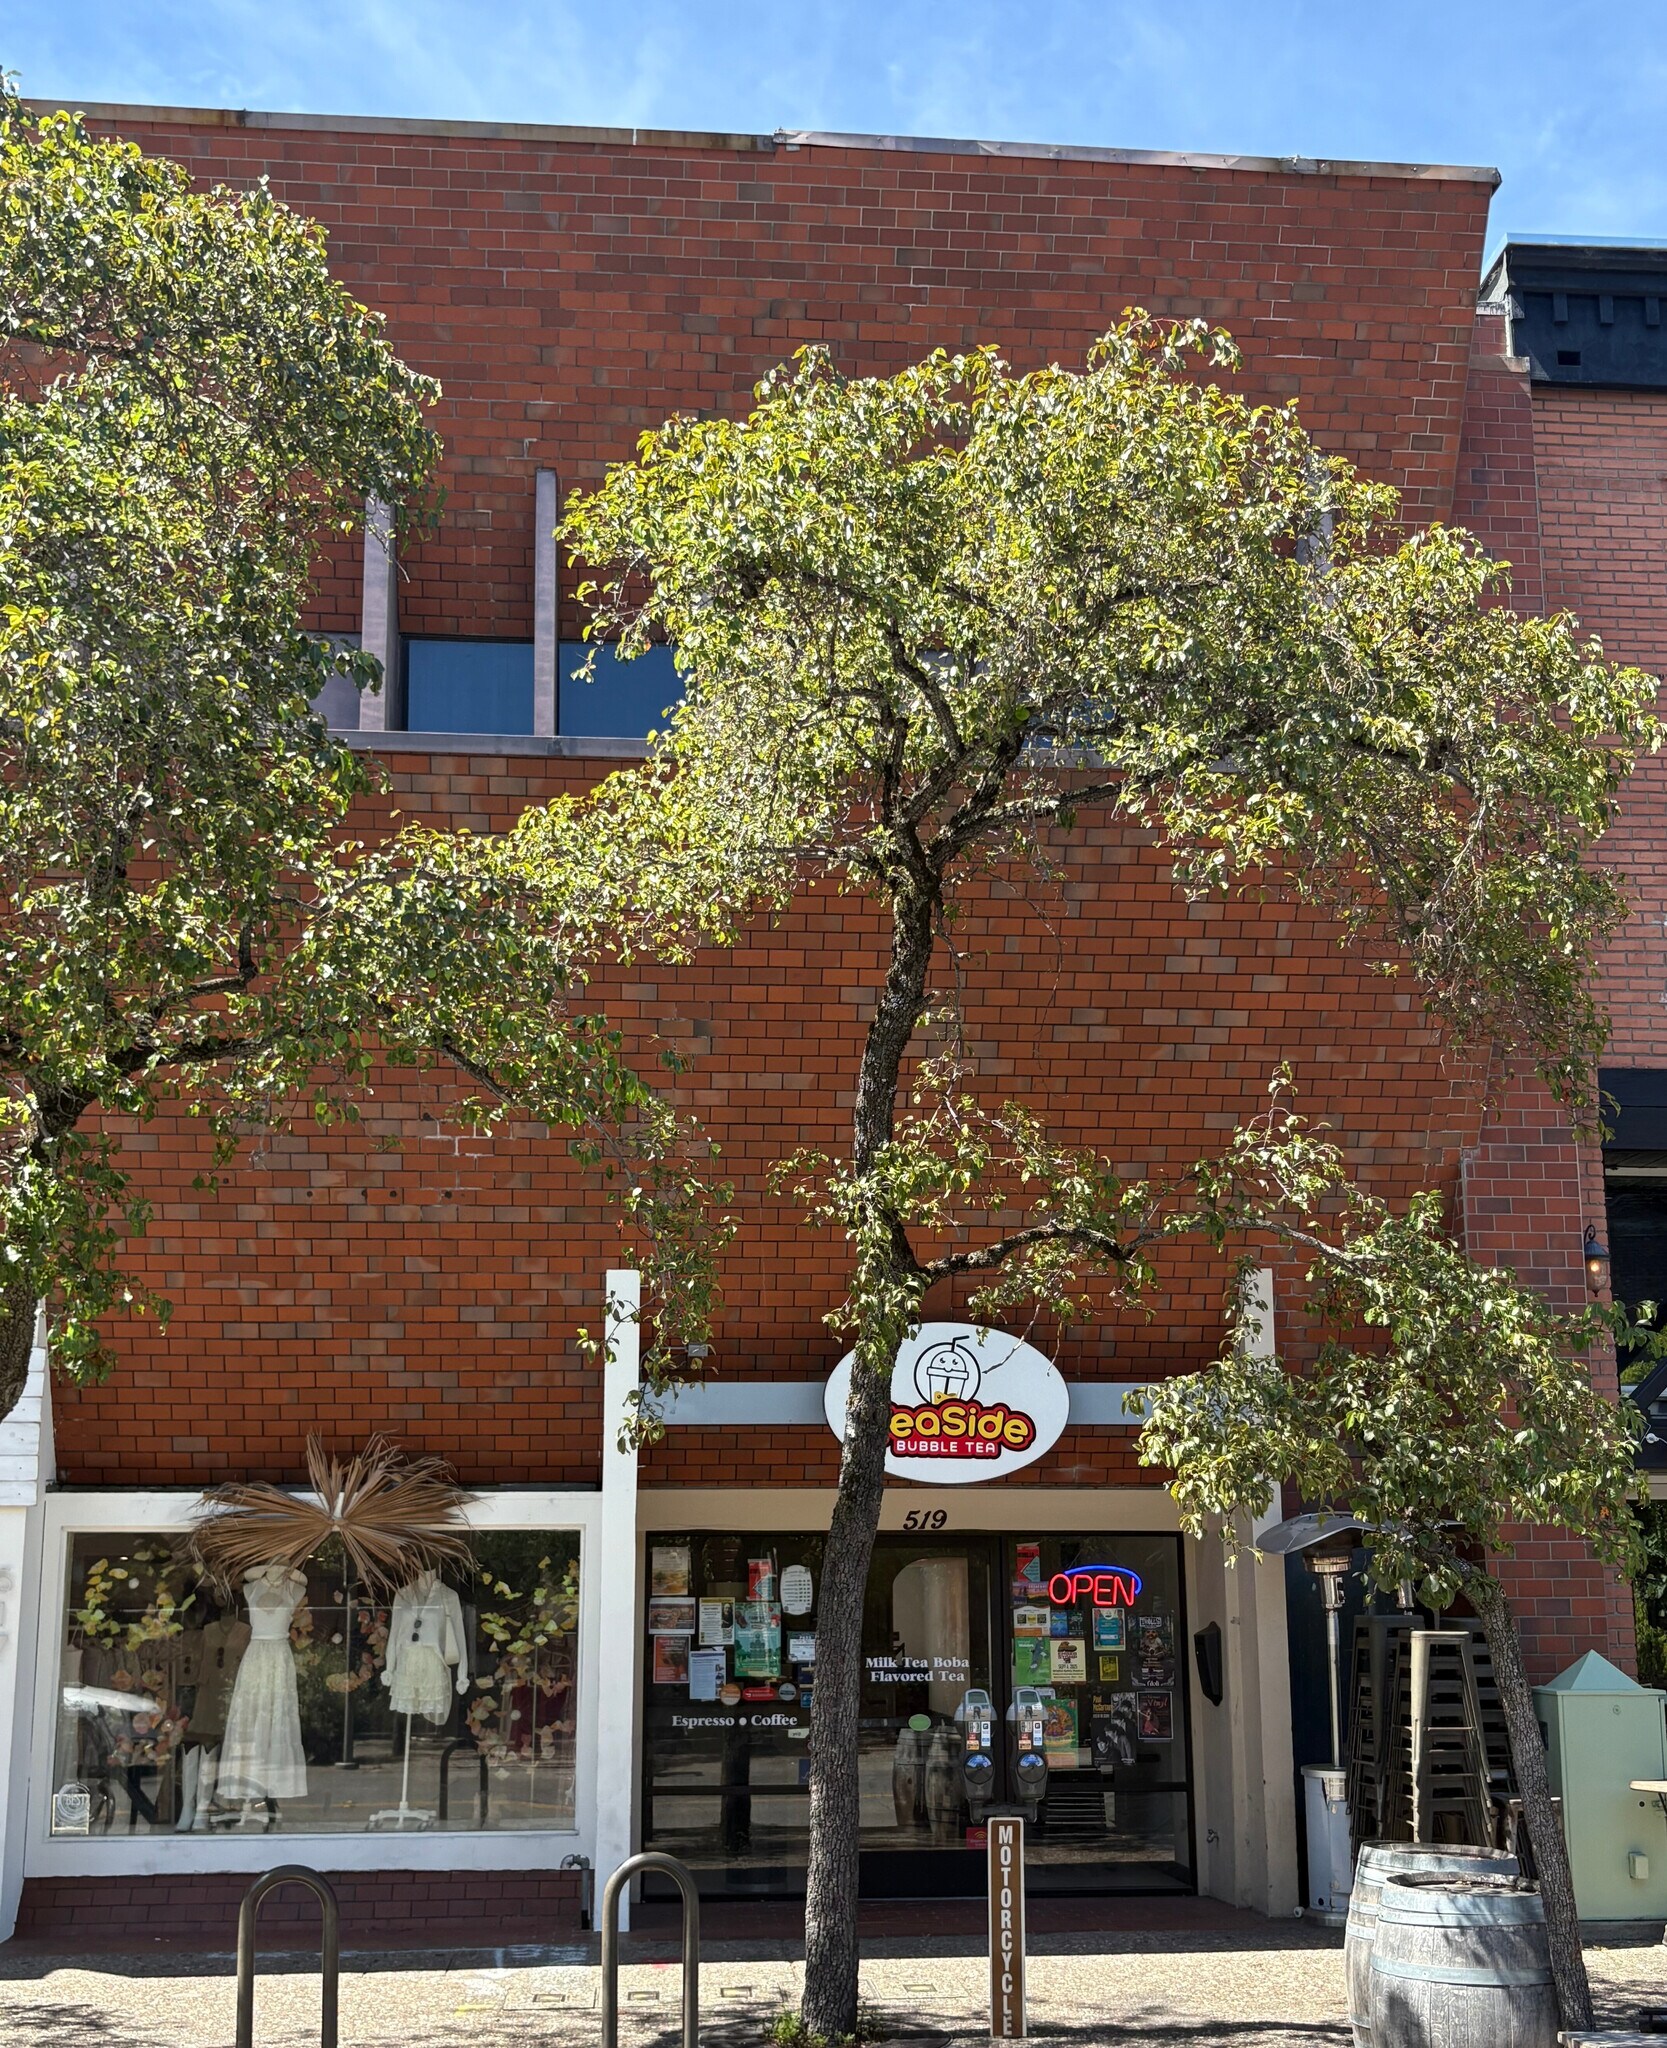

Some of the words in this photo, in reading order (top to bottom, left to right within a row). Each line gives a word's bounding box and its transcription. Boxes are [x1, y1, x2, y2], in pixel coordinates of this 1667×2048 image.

[889, 1406, 1029, 1444] eaSide
[896, 1440, 958, 1452] BUBBLE
[965, 1441, 996, 1453] TEA
[903, 1509, 947, 1530] 519
[1048, 1573, 1136, 1606] OPEN
[865, 1657, 898, 1668] Milk
[902, 1657, 928, 1668] Tea
[933, 1656, 970, 1668] Boba
[870, 1670, 934, 1682] Flavored
[938, 1671, 965, 1682] Tea
[671, 1715, 735, 1729] Espresso
[750, 1713, 798, 1726] Coffee
[998, 1825, 1014, 2036] MOTORCYCLE
